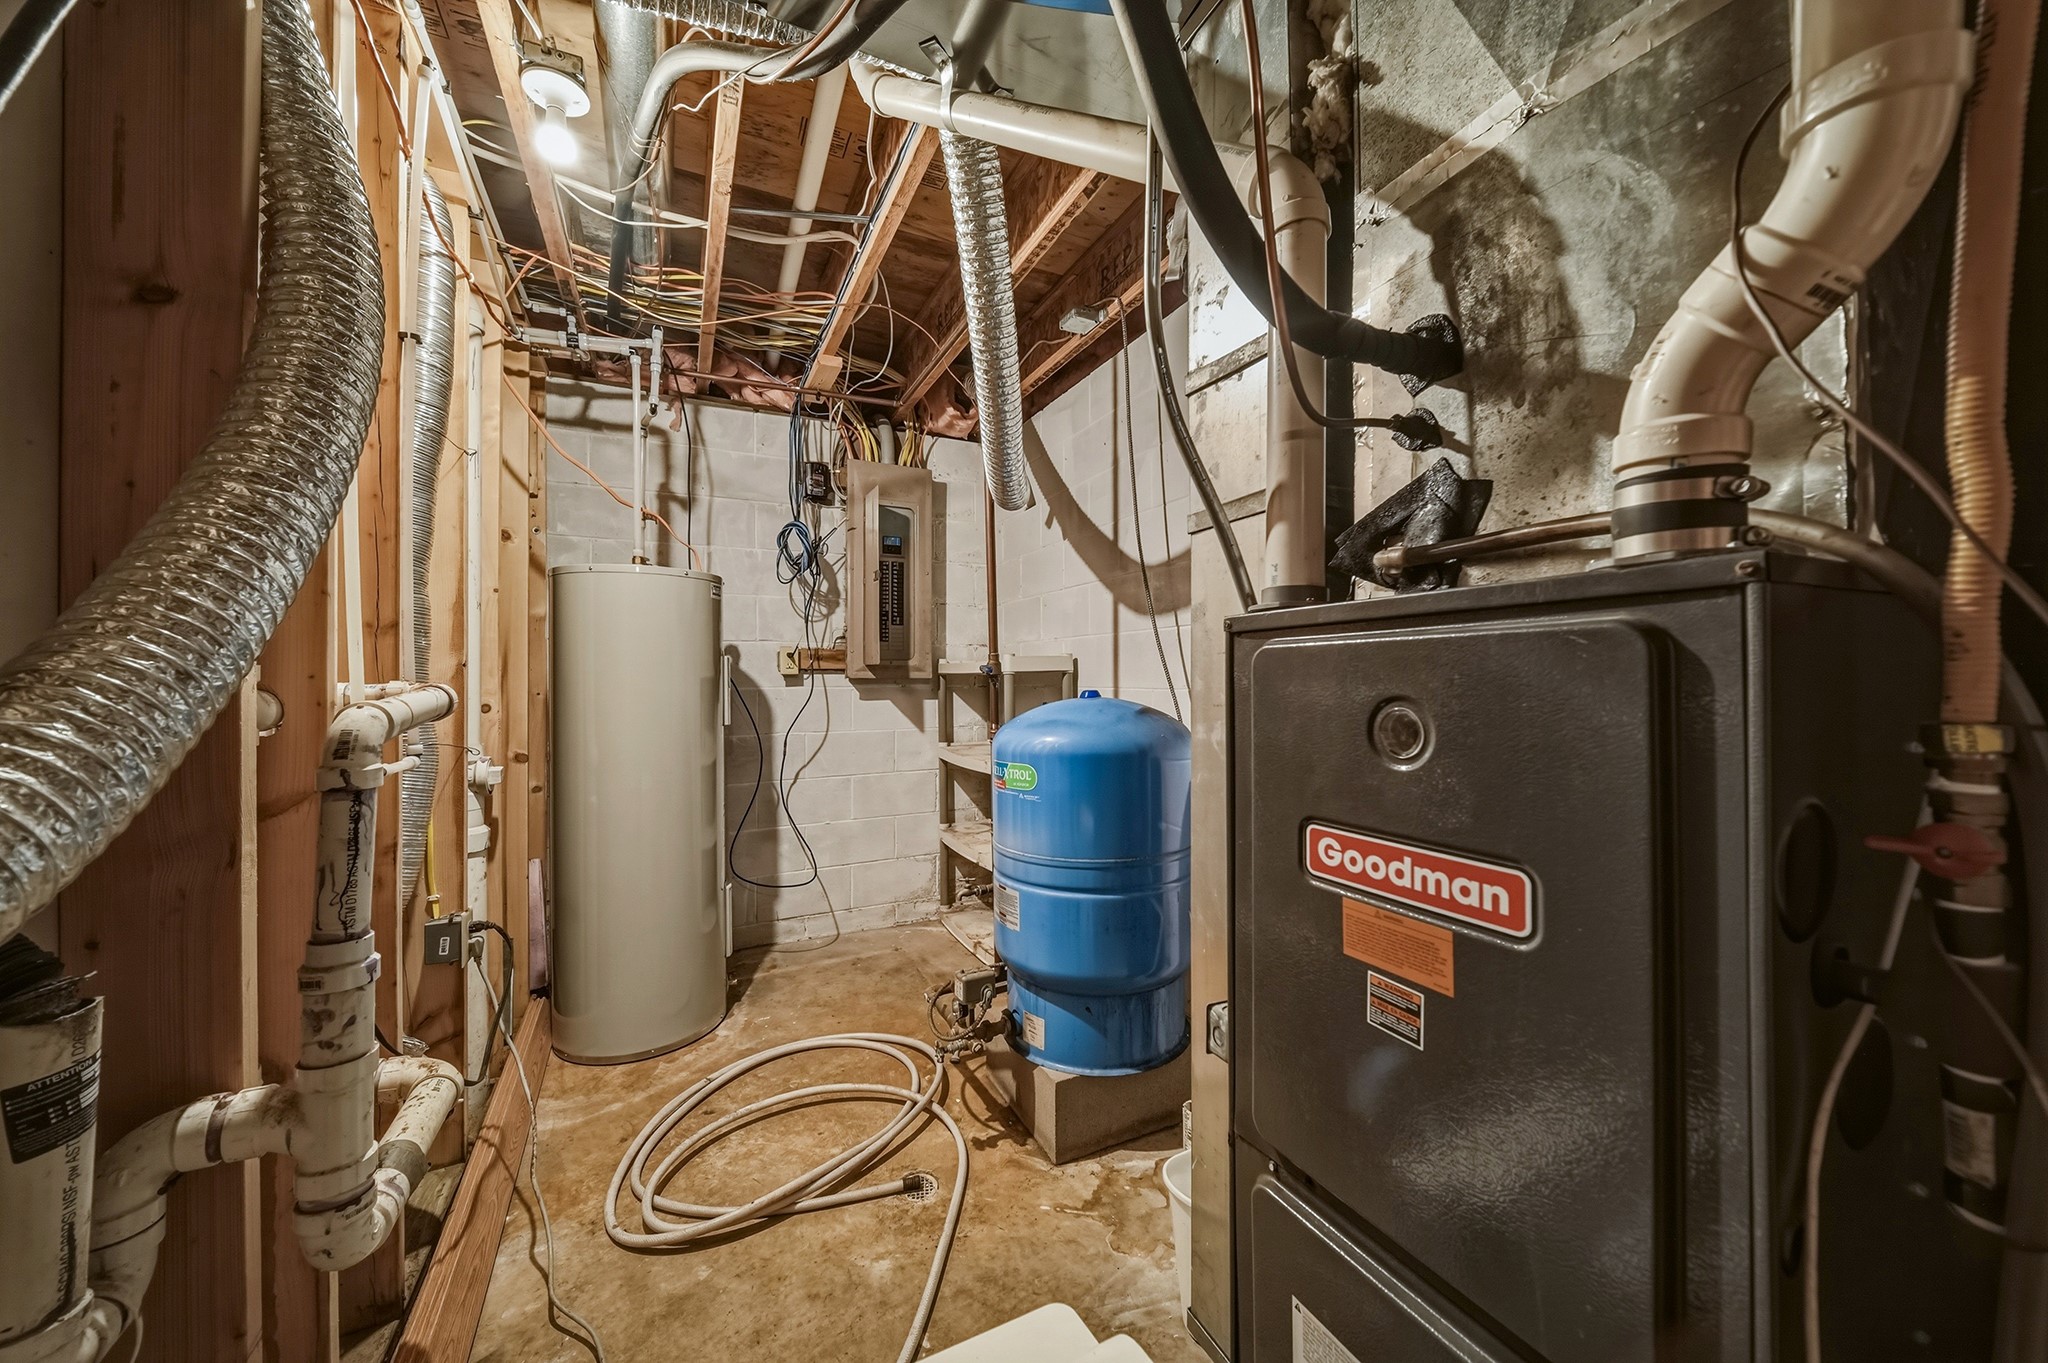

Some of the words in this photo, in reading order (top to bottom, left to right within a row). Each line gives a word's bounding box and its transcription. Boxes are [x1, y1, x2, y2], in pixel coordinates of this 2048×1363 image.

[1317, 837, 1510, 917] Goodman
[27, 1059, 93, 1092] ATTENTION
[65, 1139, 81, 1165] AST
